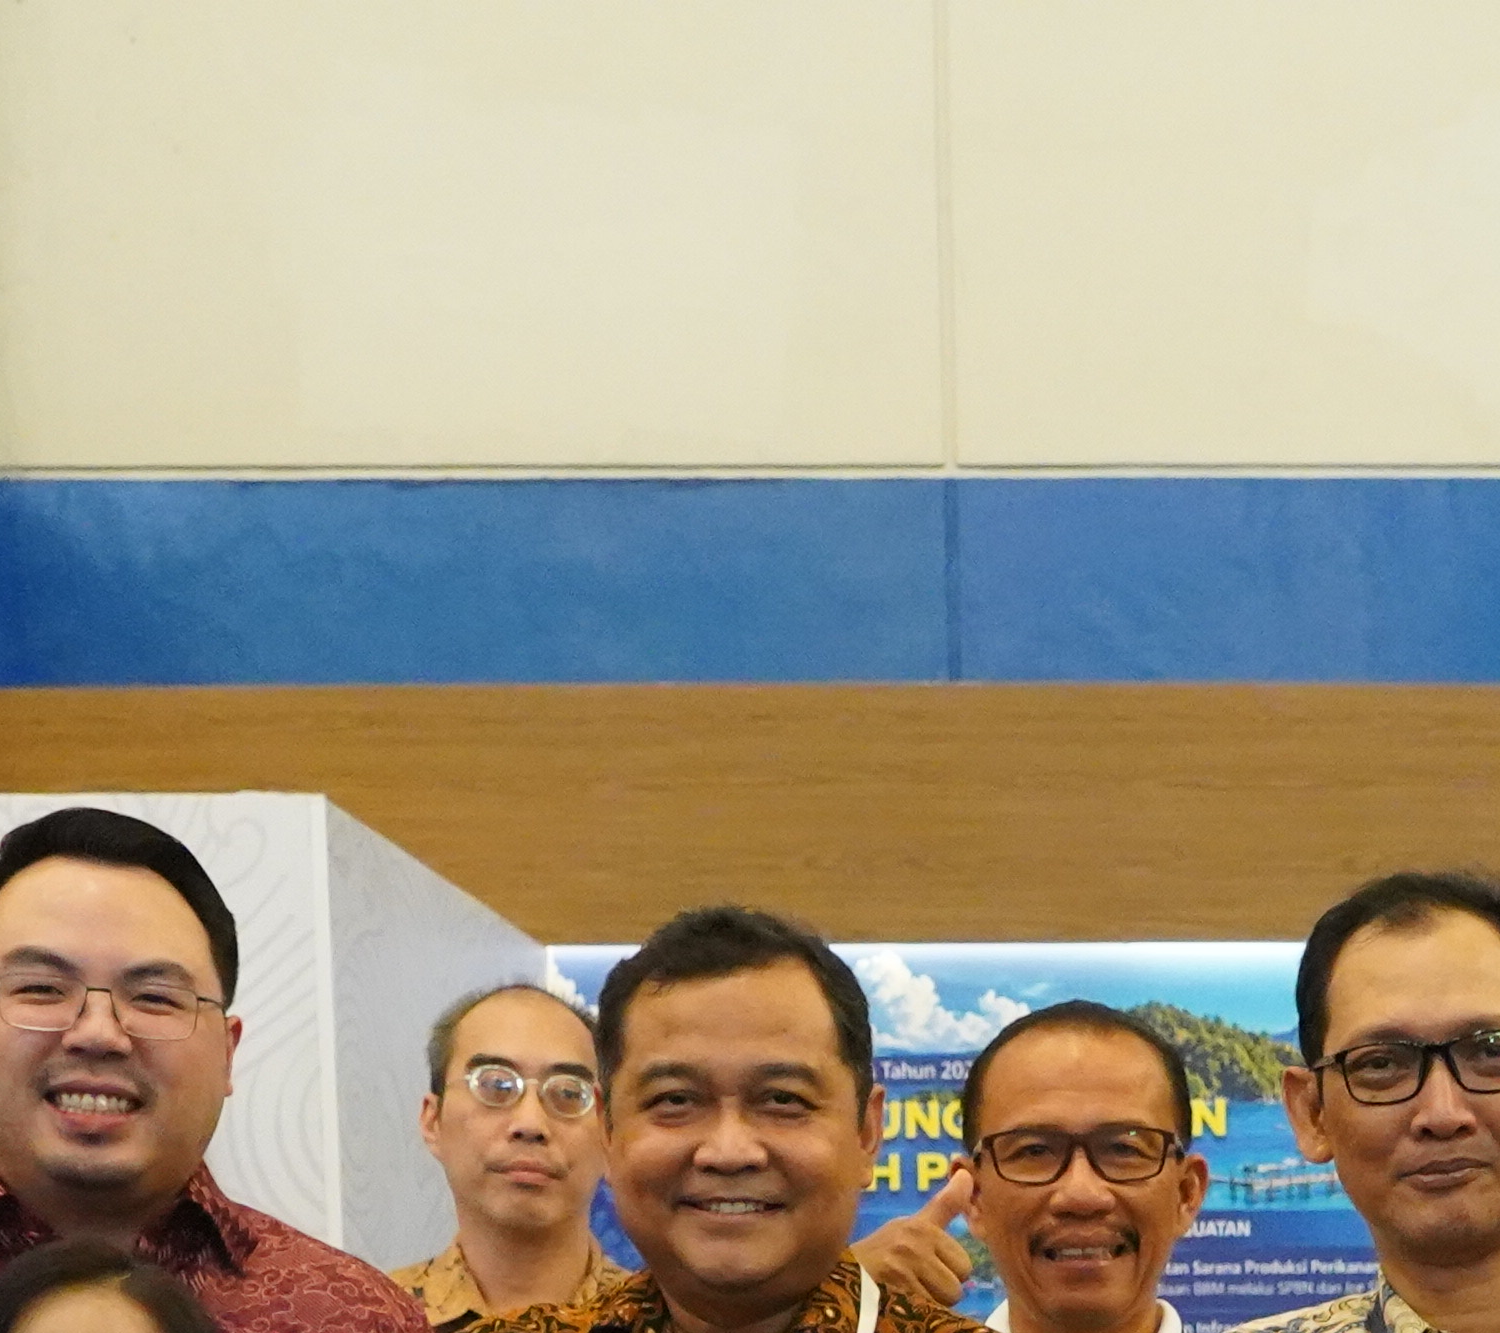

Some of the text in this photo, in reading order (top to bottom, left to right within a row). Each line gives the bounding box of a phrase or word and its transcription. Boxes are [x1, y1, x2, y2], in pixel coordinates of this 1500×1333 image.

[882, 1061, 936, 1081] Tahun
[1193, 1260, 1242, 1275] Sarana
[1244, 1259, 1308, 1275] Produksi
